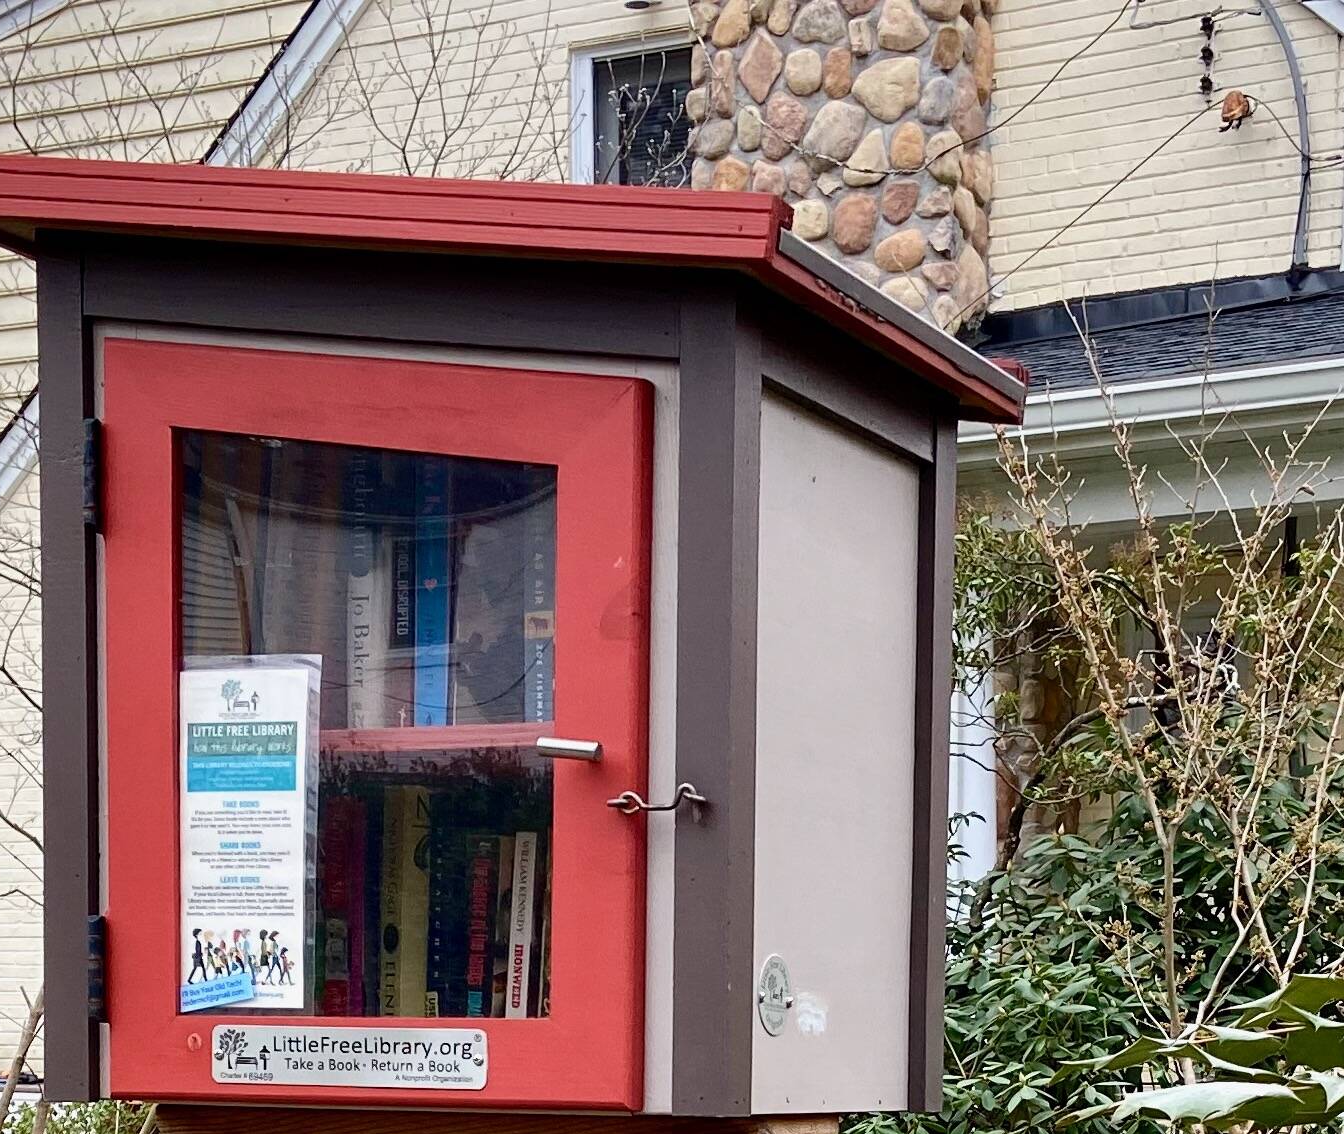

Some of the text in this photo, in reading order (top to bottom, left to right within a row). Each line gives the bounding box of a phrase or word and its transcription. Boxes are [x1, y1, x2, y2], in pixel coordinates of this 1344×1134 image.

[351, 594, 370, 616] Jo
[396, 580, 409, 637] DISRUPTED
[352, 624, 370, 689] Baker
[192, 724, 295, 737] LITTLE FREE LIBRARY
[231, 739, 263, 756] library
[515, 839, 531, 935] WILLIAM KENNEDY
[511, 943, 525, 1009] IRONWEED
[273, 1034, 473, 1060] LittleFreeLibrary.org
[284, 1057, 314, 1071] Take
[317, 1061, 325, 1071] a
[371, 1058, 413, 1072] Return
[417, 1062, 424, 1072] a
[428, 1059, 461, 1073] Book
[402, 1074, 431, 1083] Nonprofit
[431, 1075, 474, 1084] Organization
